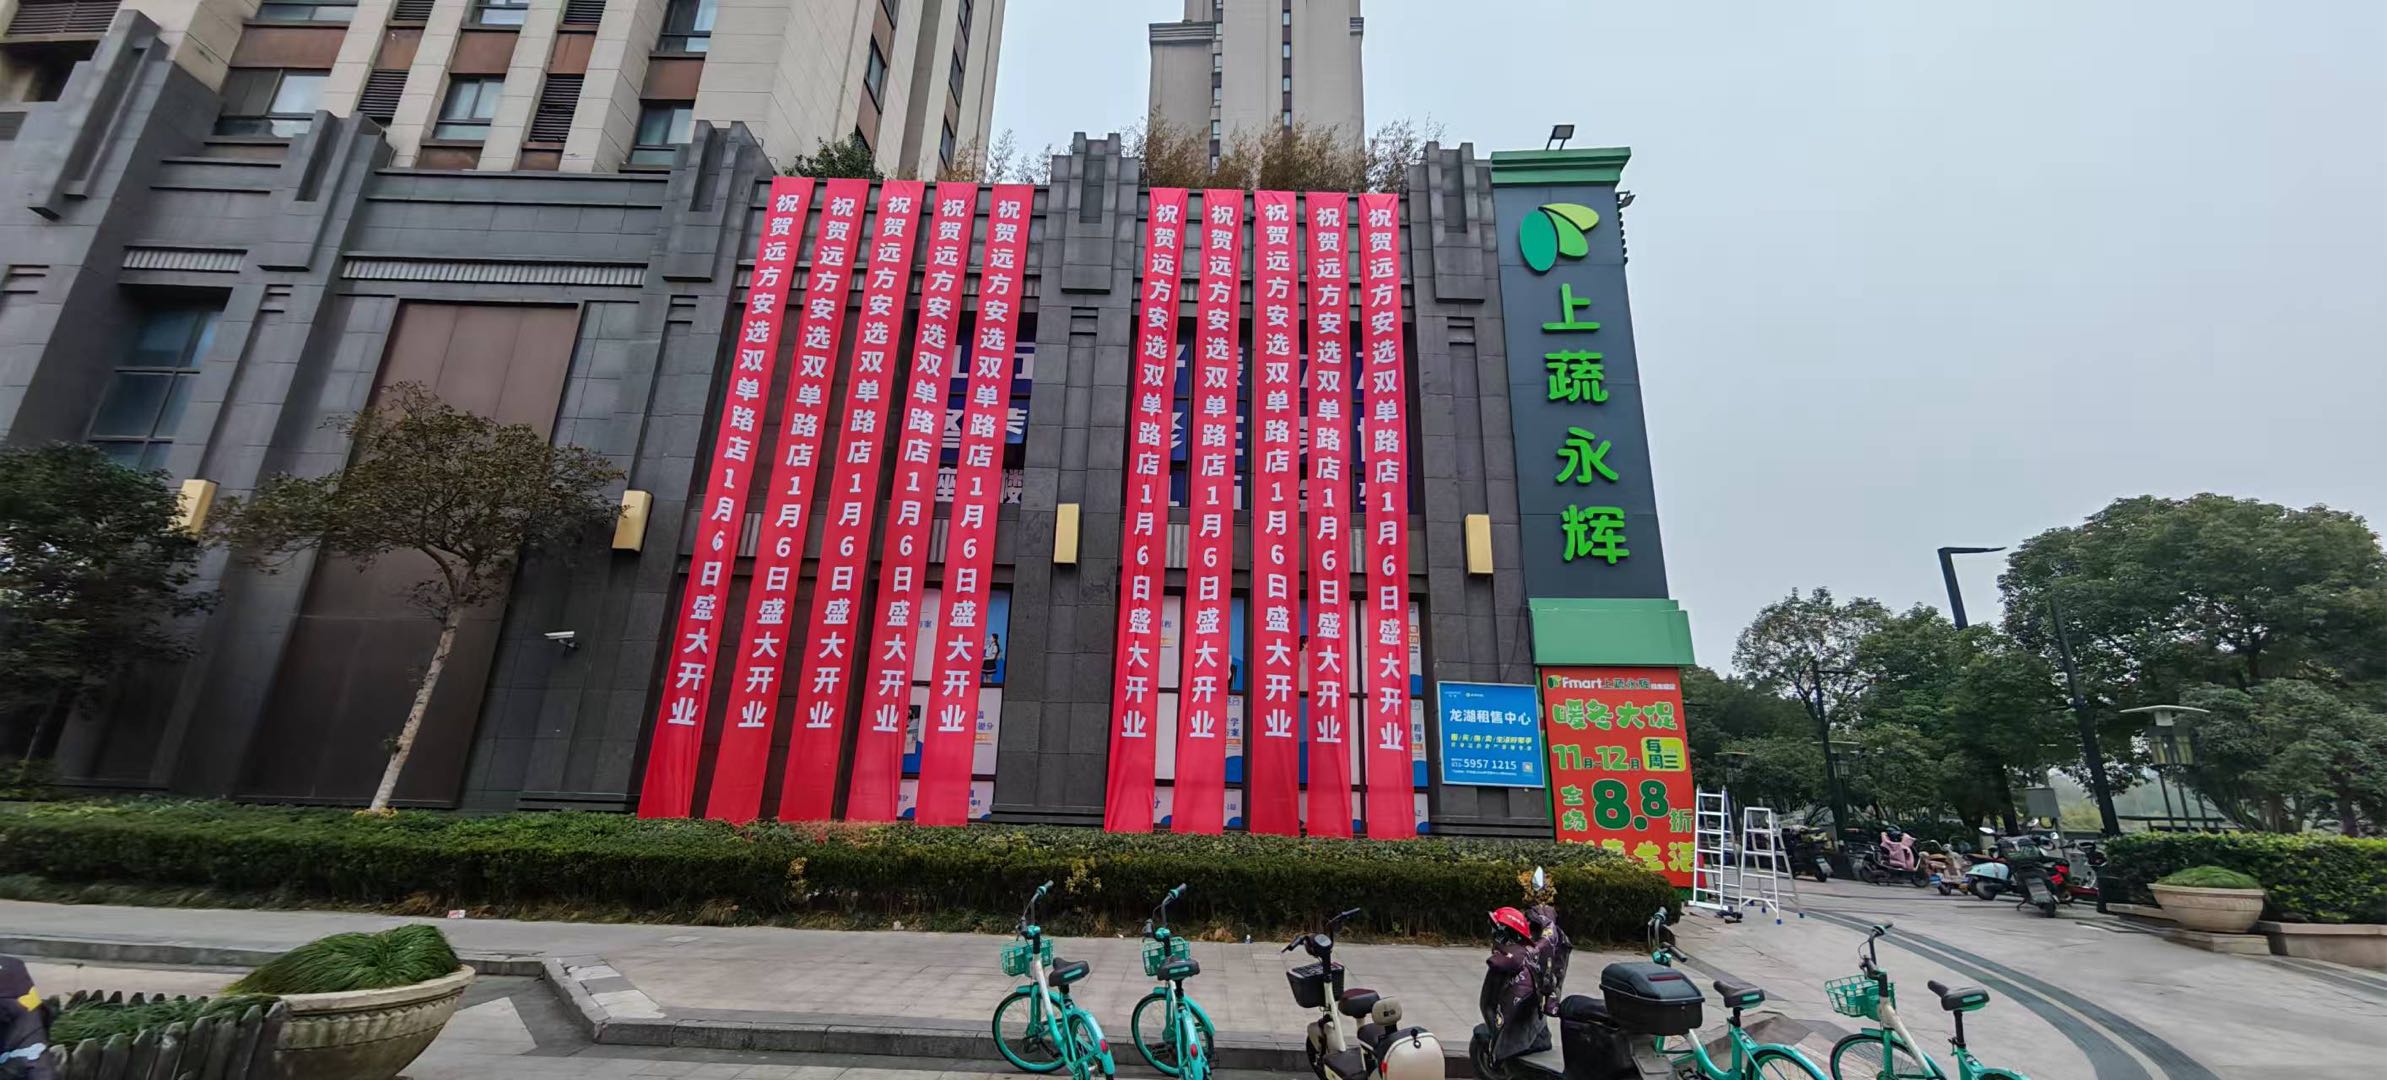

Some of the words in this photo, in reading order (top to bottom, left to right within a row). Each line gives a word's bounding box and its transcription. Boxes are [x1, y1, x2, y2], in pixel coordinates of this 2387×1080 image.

[667, 194, 800, 727] 祝贺远方安选双单路店1月6日盛大开业
[738, 196, 855, 728] 祝贺远方安选双单路店1月6日盛大开业
[806, 196, 912, 729] 祝贺远方安选双单路店1月6日盛大开业
[872, 199, 966, 732] 祝贺远方安选双单路店1月6日盛大开业
[938, 200, 1021, 732] 祝贺远方安选双单路店1月6日盛大开业
[1121, 203, 1179, 738] 祝贺远方安选双单路店1月6日盛大开业
[1189, 205, 1234, 738] 祝贺远方安选双单路店1月6日盛大开业
[1264, 203, 1292, 738] 祝贺远方安选双单路店1月6日盛大开业
[1316, 207, 1342, 744] 祝贺远方安选双单路店1月6日盛大开业
[1368, 209, 1404, 751] 祝贺远方安选双单路店1月6日盛大开业
[1541, 282, 1631, 566] 上蔬永辉
[1561, 676, 1602, 690] Fmart
[1449, 707, 1532, 726] 龙湖租售中心
[1491, 760, 1517, 770] 1215
[1551, 698, 1678, 731] 暖冬大促
